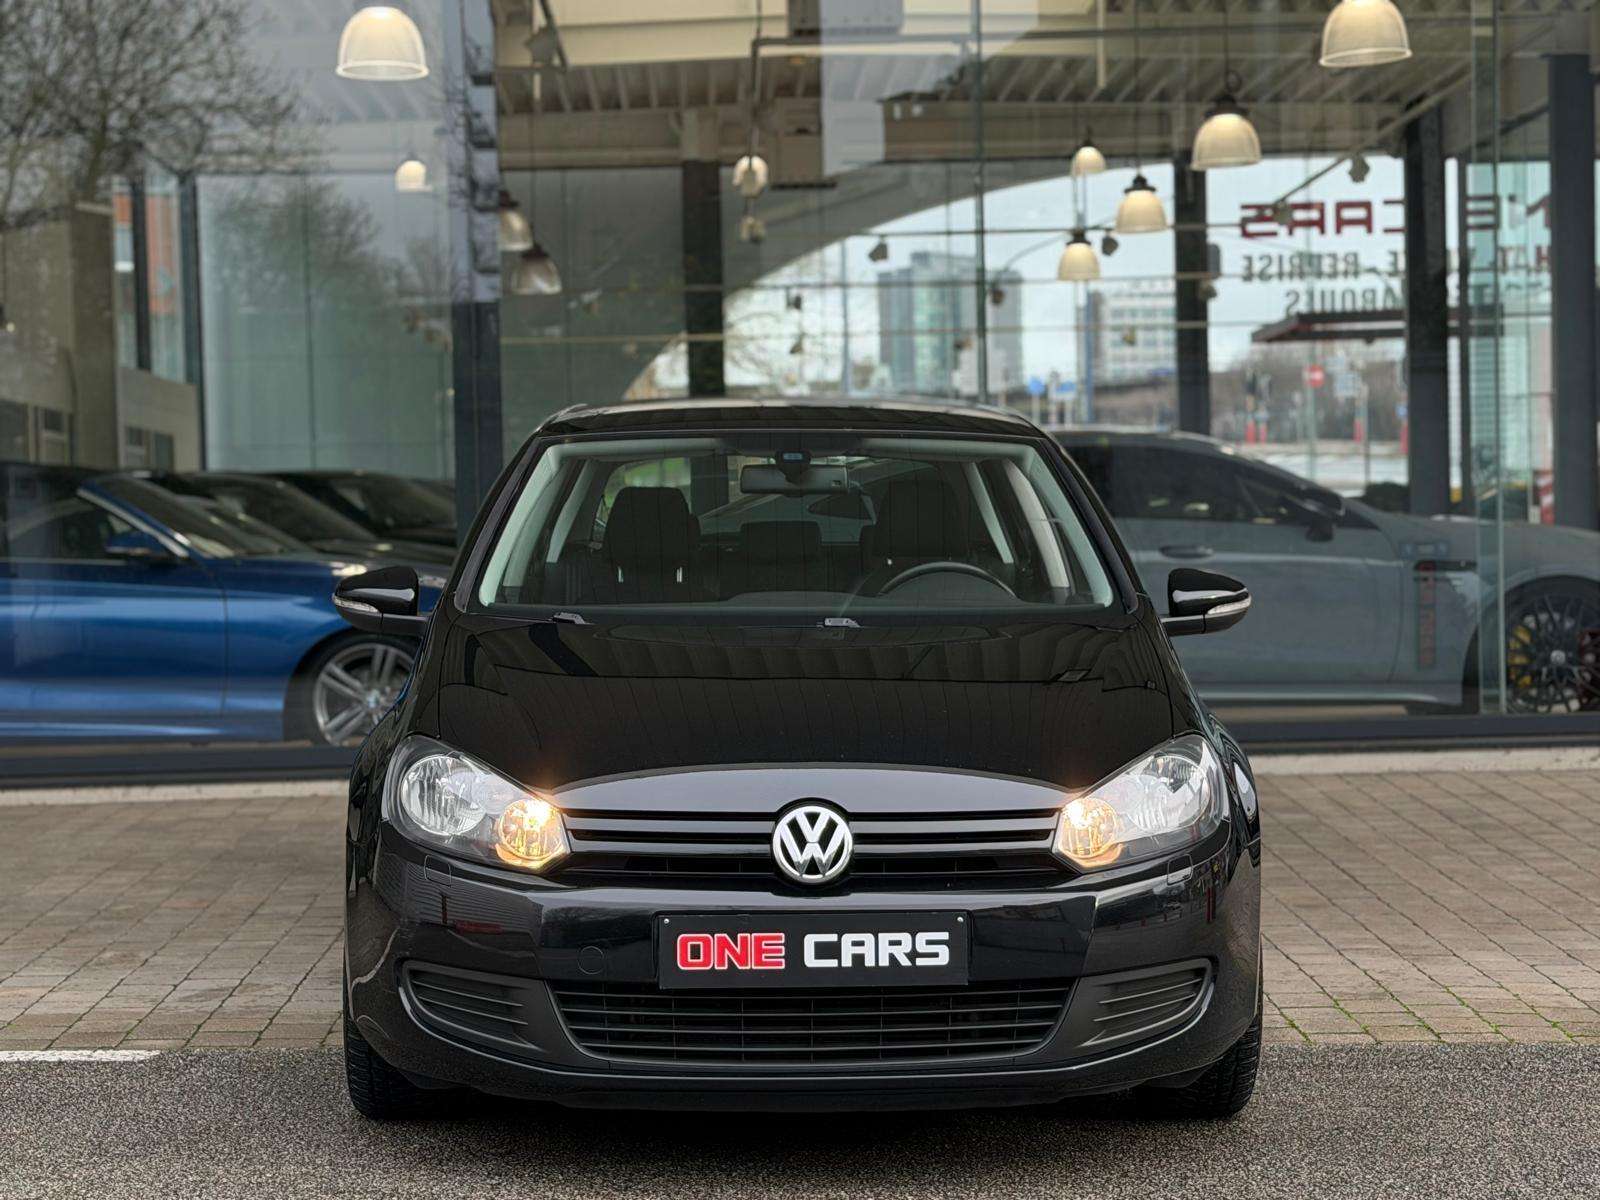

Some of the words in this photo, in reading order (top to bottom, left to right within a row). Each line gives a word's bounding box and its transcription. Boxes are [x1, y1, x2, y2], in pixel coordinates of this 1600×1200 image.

[774, 806, 851, 882] VW
[676, 932, 786, 970] ONE
[803, 931, 950, 967] CARS
